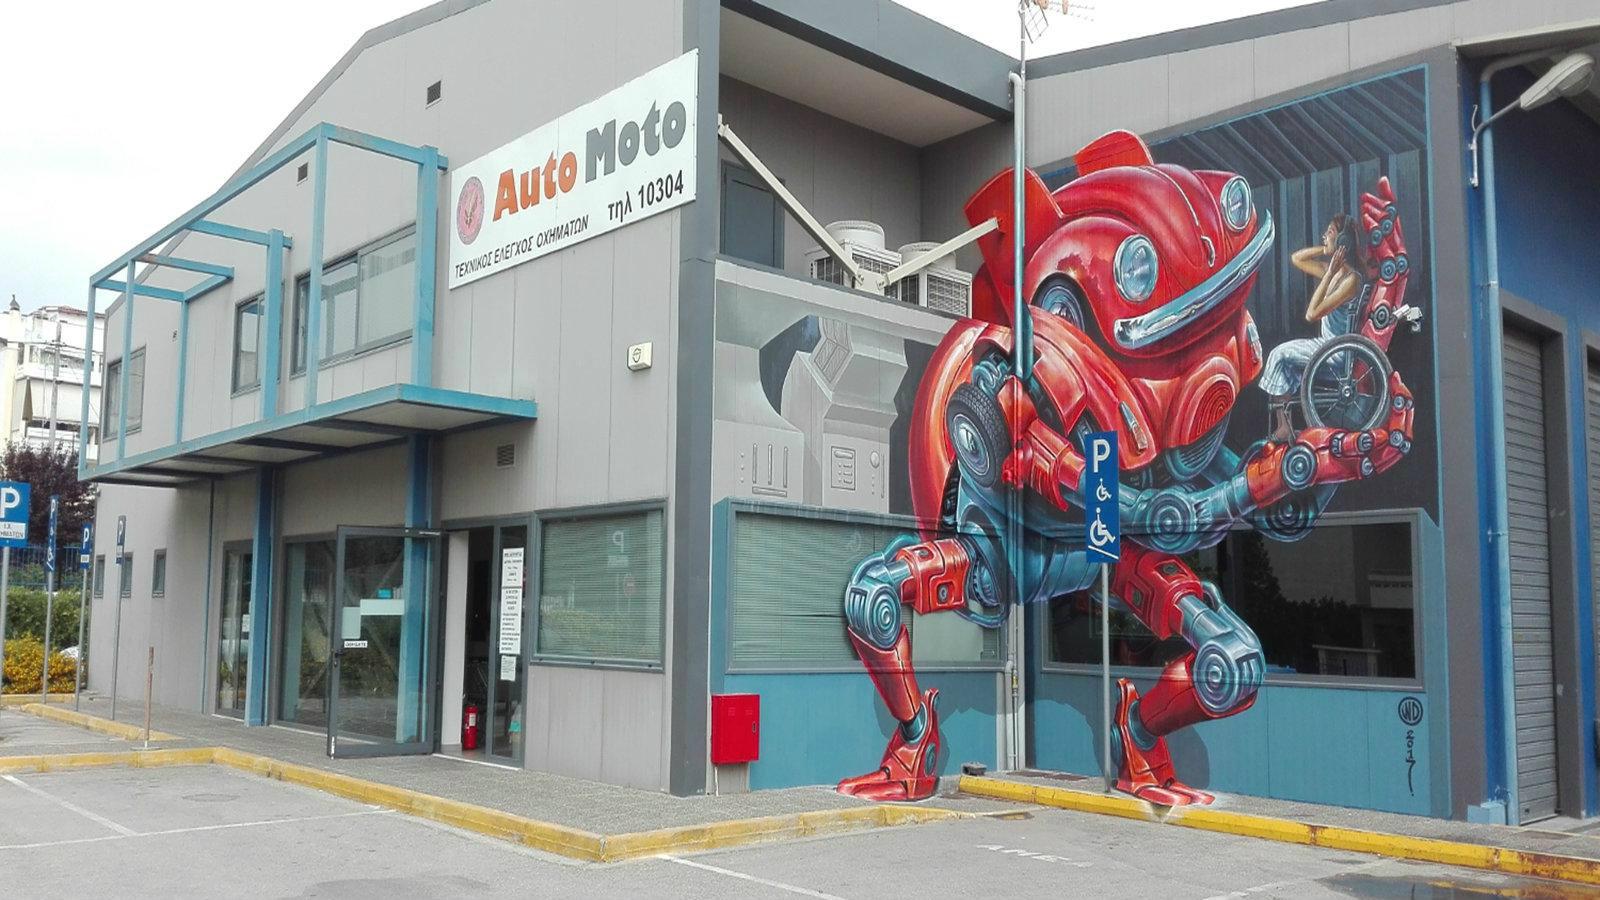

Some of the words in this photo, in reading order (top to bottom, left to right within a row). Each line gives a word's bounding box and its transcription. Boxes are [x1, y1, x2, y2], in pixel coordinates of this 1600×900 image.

[493, 150, 577, 222] Auto
[585, 99, 687, 183] Moto
[607, 191, 632, 223] τηλ
[638, 169, 684, 209] 10304
[455, 251, 493, 279] ΤΕΧΝΙΚΟΣ
[494, 235, 534, 264] ΕΛΕΓΧΟΣ
[536, 214, 589, 248] ΟΧΗΜΑΤΩΝ
[1093, 438, 1110, 473] P
[0, 486, 20, 519] P
[83, 527, 90, 550] P
